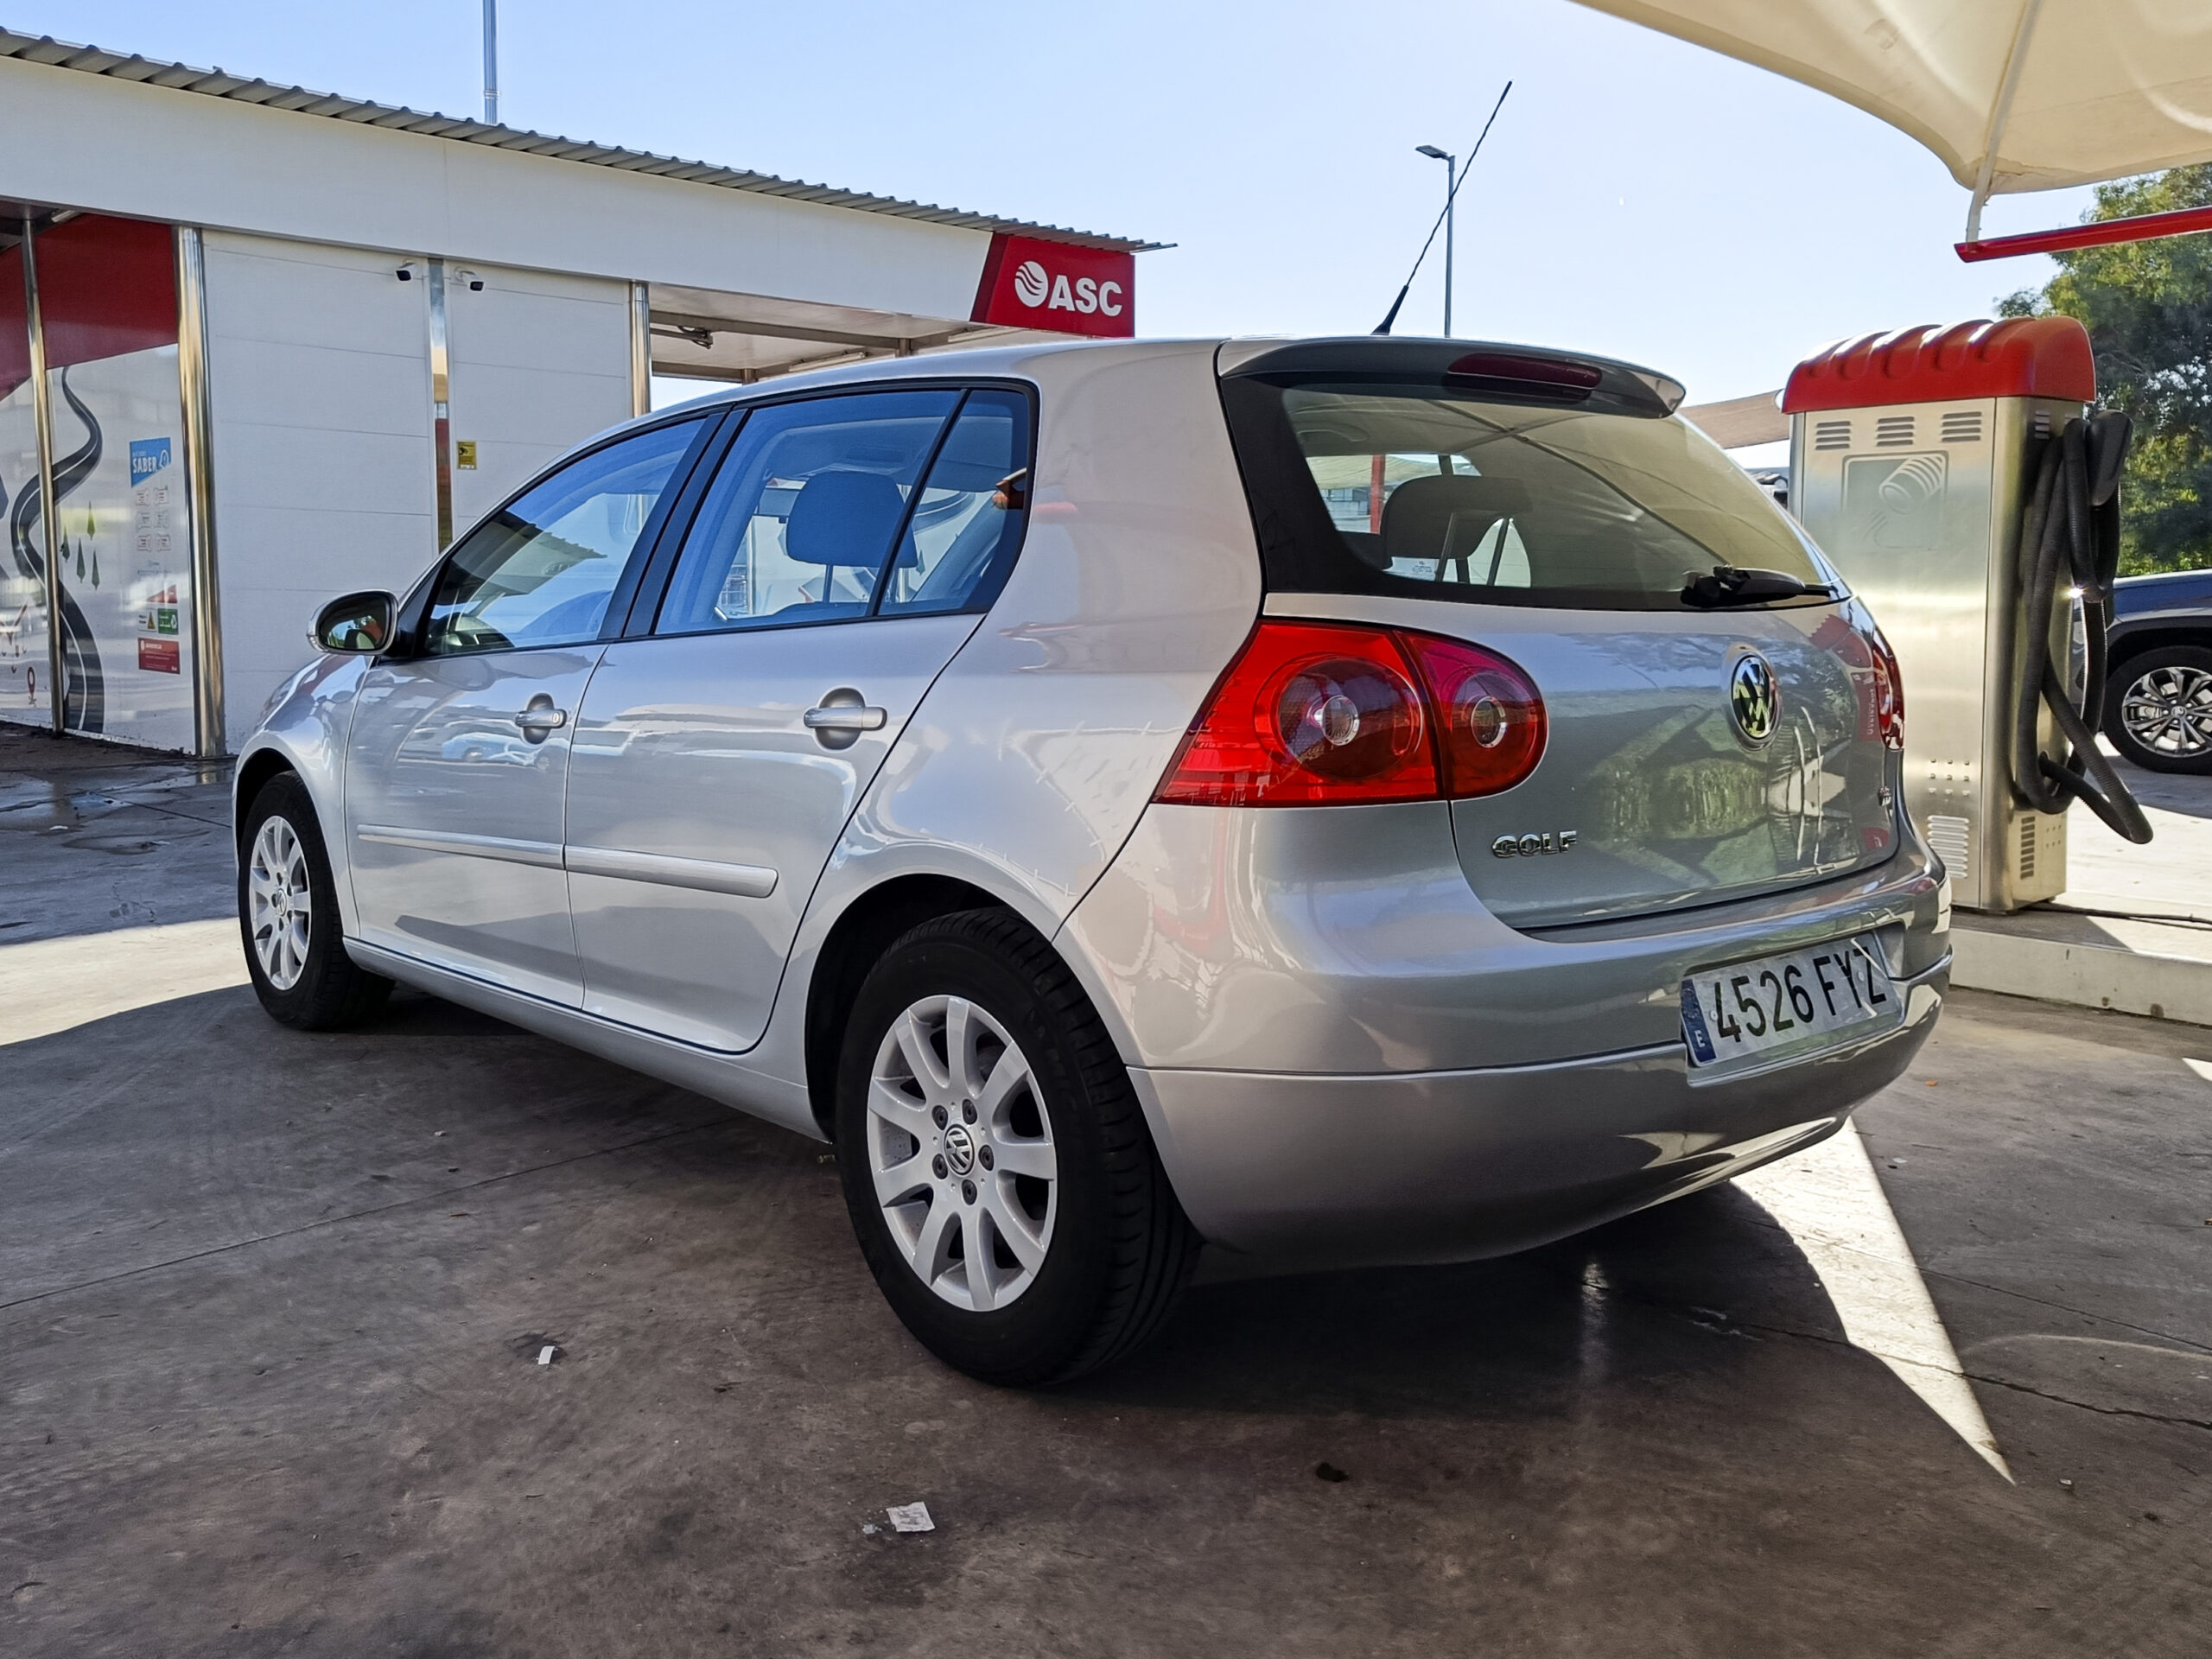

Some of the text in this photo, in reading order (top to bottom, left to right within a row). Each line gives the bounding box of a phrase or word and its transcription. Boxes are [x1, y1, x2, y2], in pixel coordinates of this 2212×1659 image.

[1048, 275, 1122, 316] ASC
[132, 456, 158, 474] SABER
[1492, 830, 1577, 858] GOLF
[1714, 946, 1886, 1043] 4526 FYZ
[1694, 1029, 1706, 1047] E
